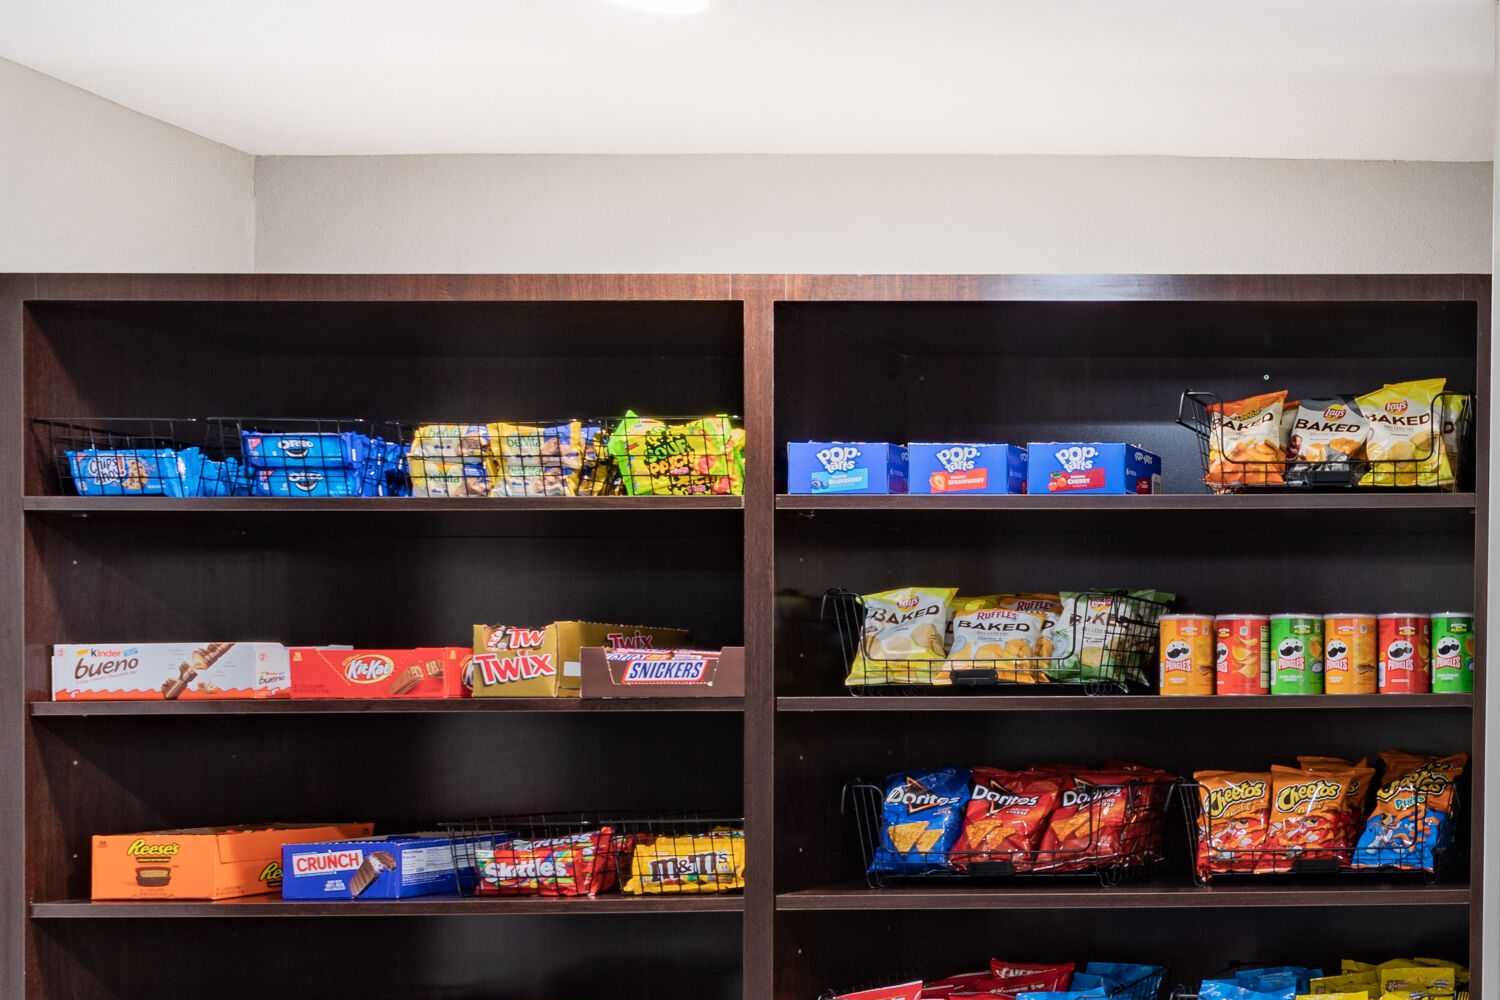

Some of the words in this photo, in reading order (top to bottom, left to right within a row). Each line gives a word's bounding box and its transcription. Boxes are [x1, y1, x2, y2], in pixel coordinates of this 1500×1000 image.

[1296, 418, 1361, 433] BAKED
[1366, 413, 1430, 426] BAKED
[977, 611, 1017, 621] RUFFLES
[958, 620, 1030, 633] BAKED
[92, 649, 122, 658] kinder
[74, 657, 139, 680] bueno
[630, 661, 703, 679] SNICKERS
[259, 675, 286, 687] bueno
[886, 785, 960, 806] Doritos
[972, 784, 1040, 807] Doritos
[1205, 781, 1266, 818] Cheetos
[1278, 781, 1342, 811] Cheetos
[297, 852, 360, 873] CRUNCH
[485, 859, 567, 883] Skittles
